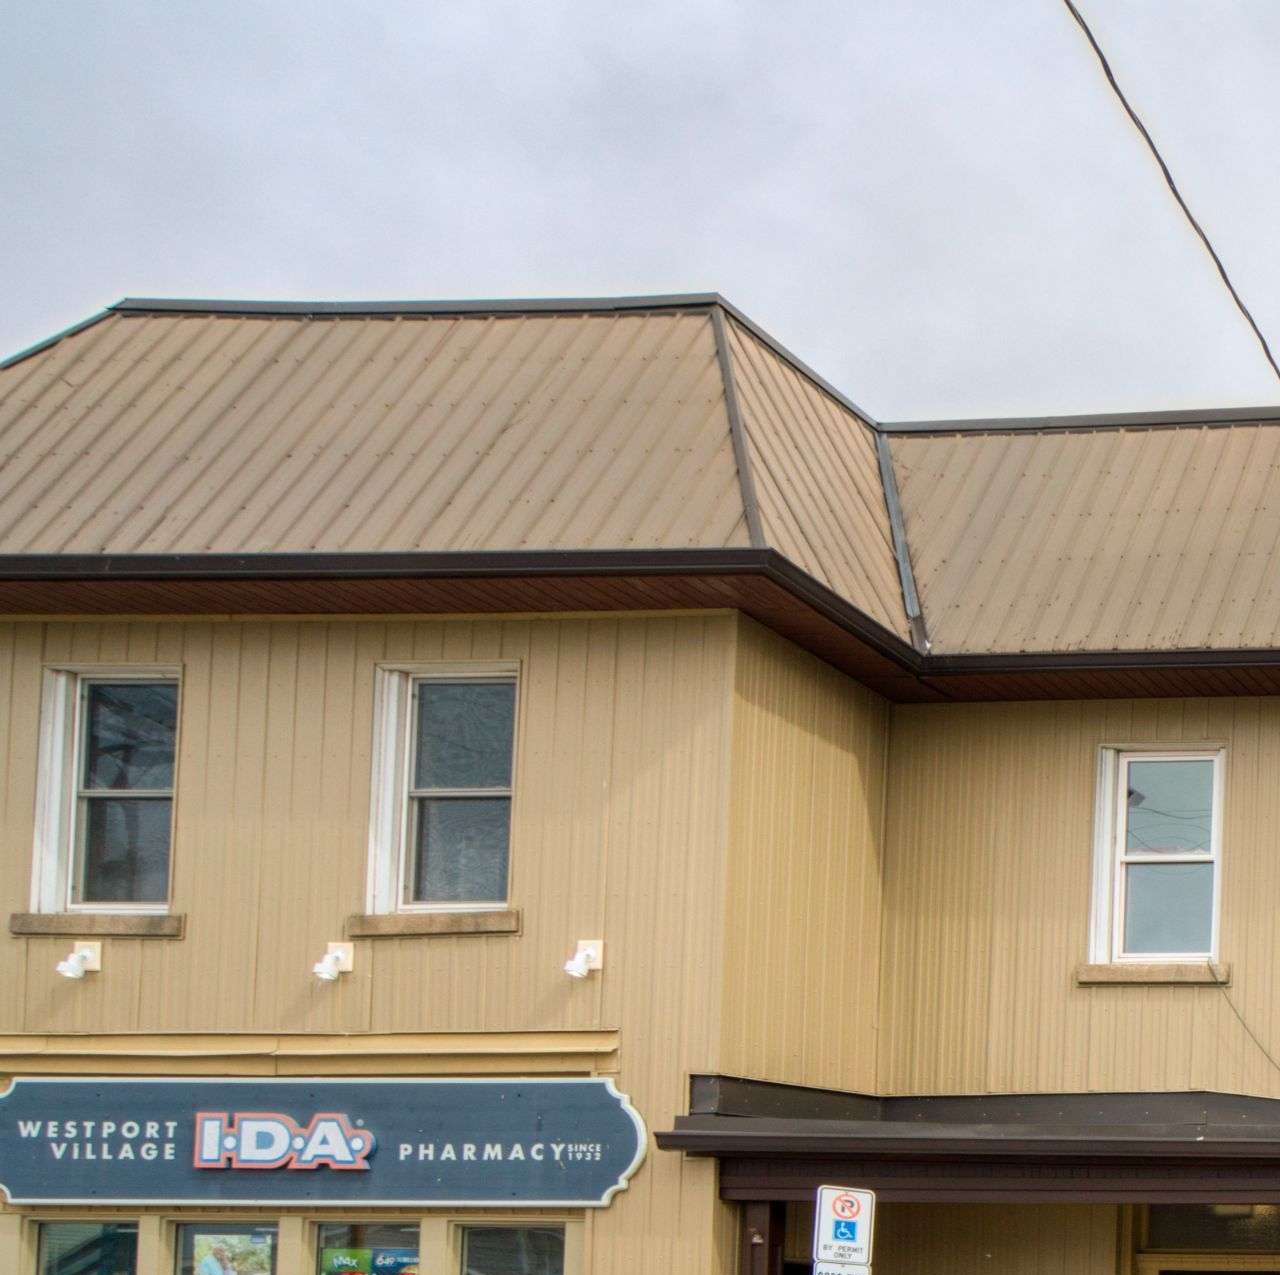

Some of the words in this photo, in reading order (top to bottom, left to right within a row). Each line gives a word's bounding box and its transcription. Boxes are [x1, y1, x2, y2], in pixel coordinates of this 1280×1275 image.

[18, 1121, 178, 1138] WESTPORT
[50, 1143, 176, 1160] VILLAGE
[400, 1143, 566, 1161] PHARMACY
[567, 1144, 601, 1152] SINCE
[833, 1251, 852, 1259] ONLY
